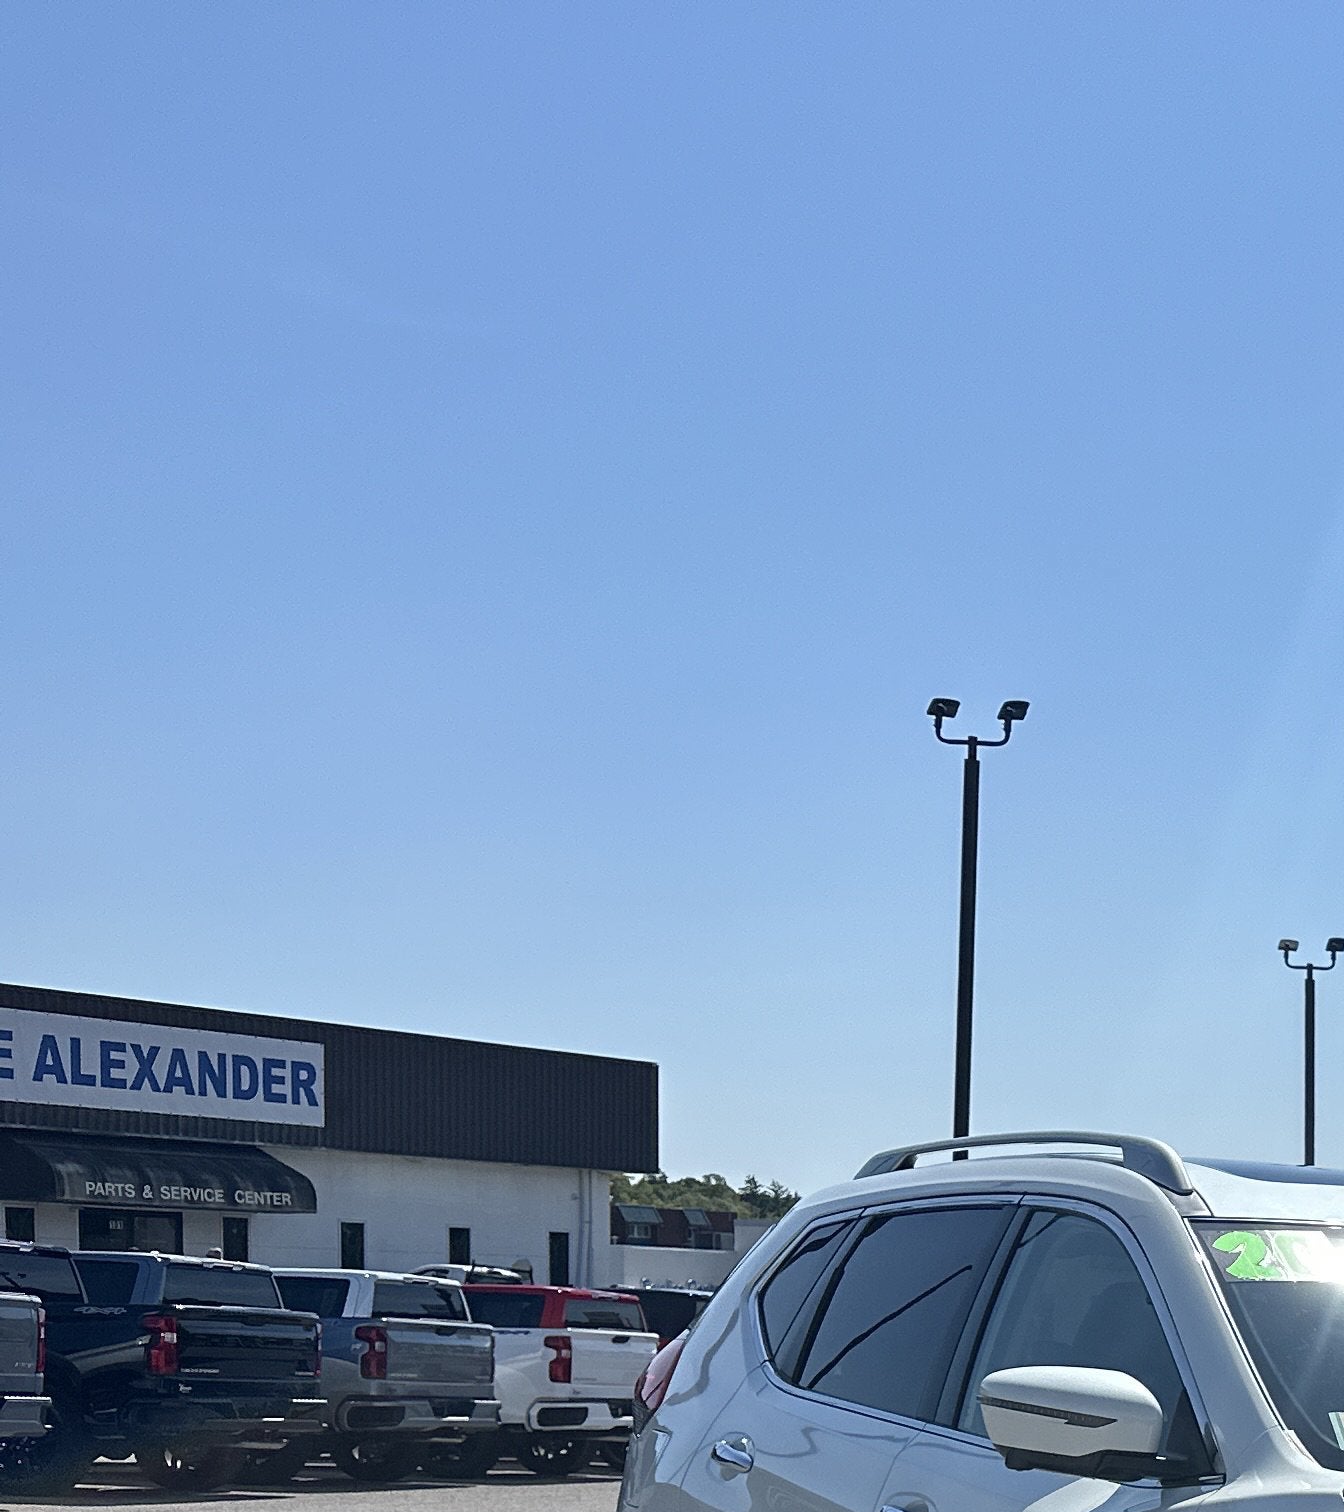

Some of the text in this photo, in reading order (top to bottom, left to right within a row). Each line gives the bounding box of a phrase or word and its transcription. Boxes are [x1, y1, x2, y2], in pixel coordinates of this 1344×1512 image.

[32, 1034, 319, 1107] ALEXANDER
[85, 1181, 292, 1206] PARTS & SERVICE CENTER
